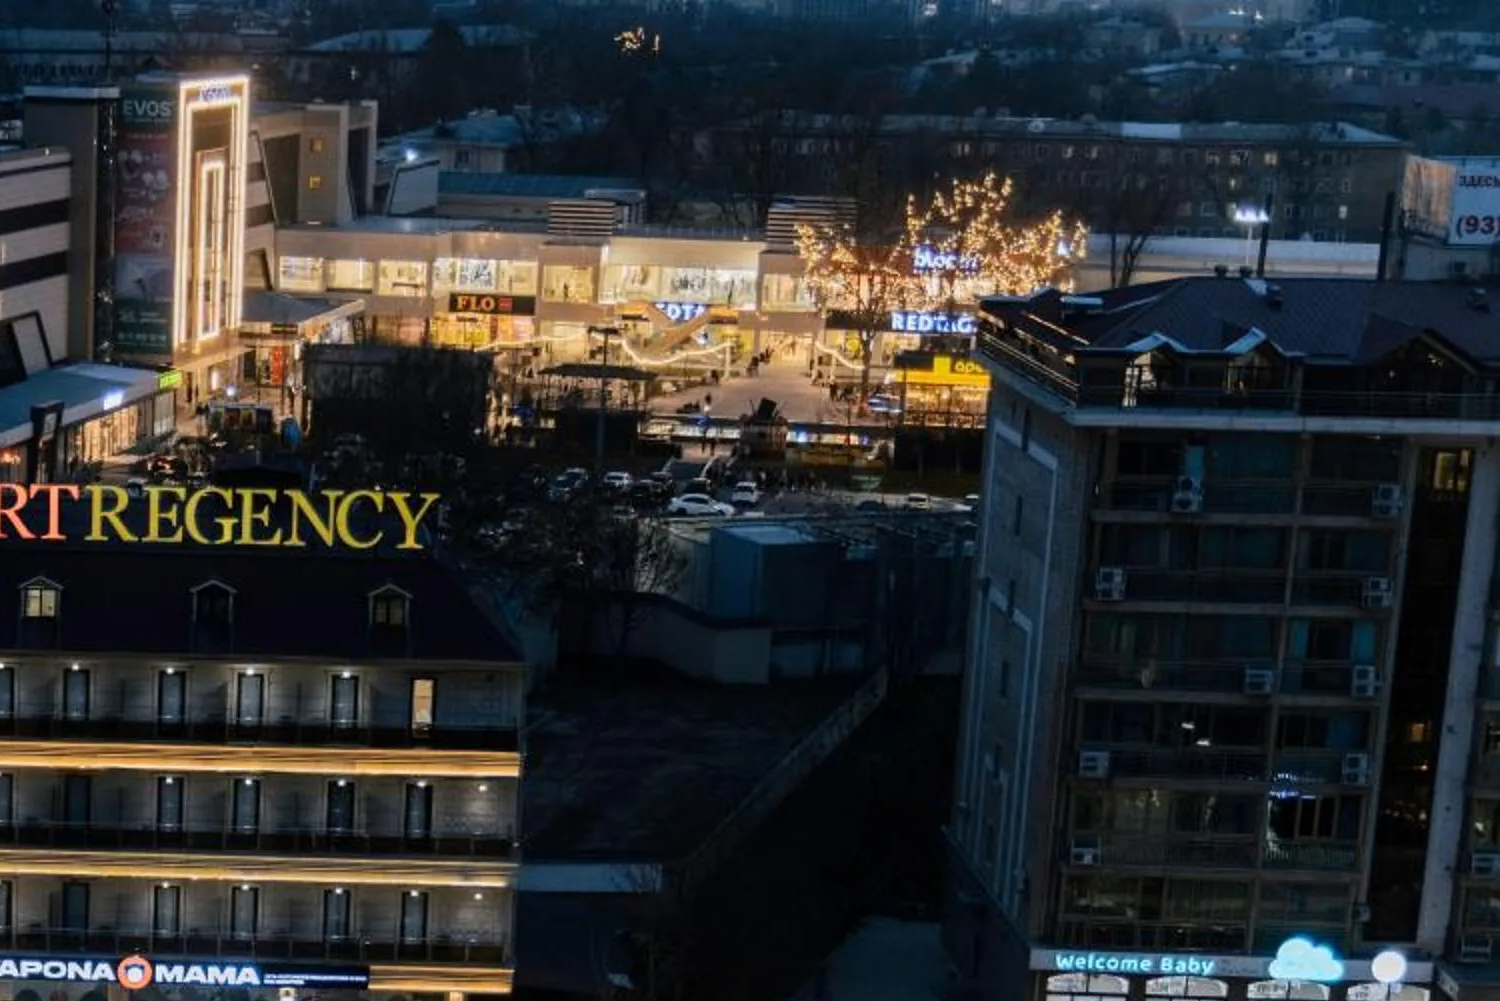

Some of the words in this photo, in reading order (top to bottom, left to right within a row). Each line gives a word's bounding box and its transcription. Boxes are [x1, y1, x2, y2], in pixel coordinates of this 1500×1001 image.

[123, 99, 172, 117] EVOS
[456, 295, 496, 312] FLO
[84, 485, 441, 549] REGENCY
[1055, 953, 1151, 972] Welcome
[1161, 956, 1215, 976] Baby
[155, 965, 260, 985] MAMA
